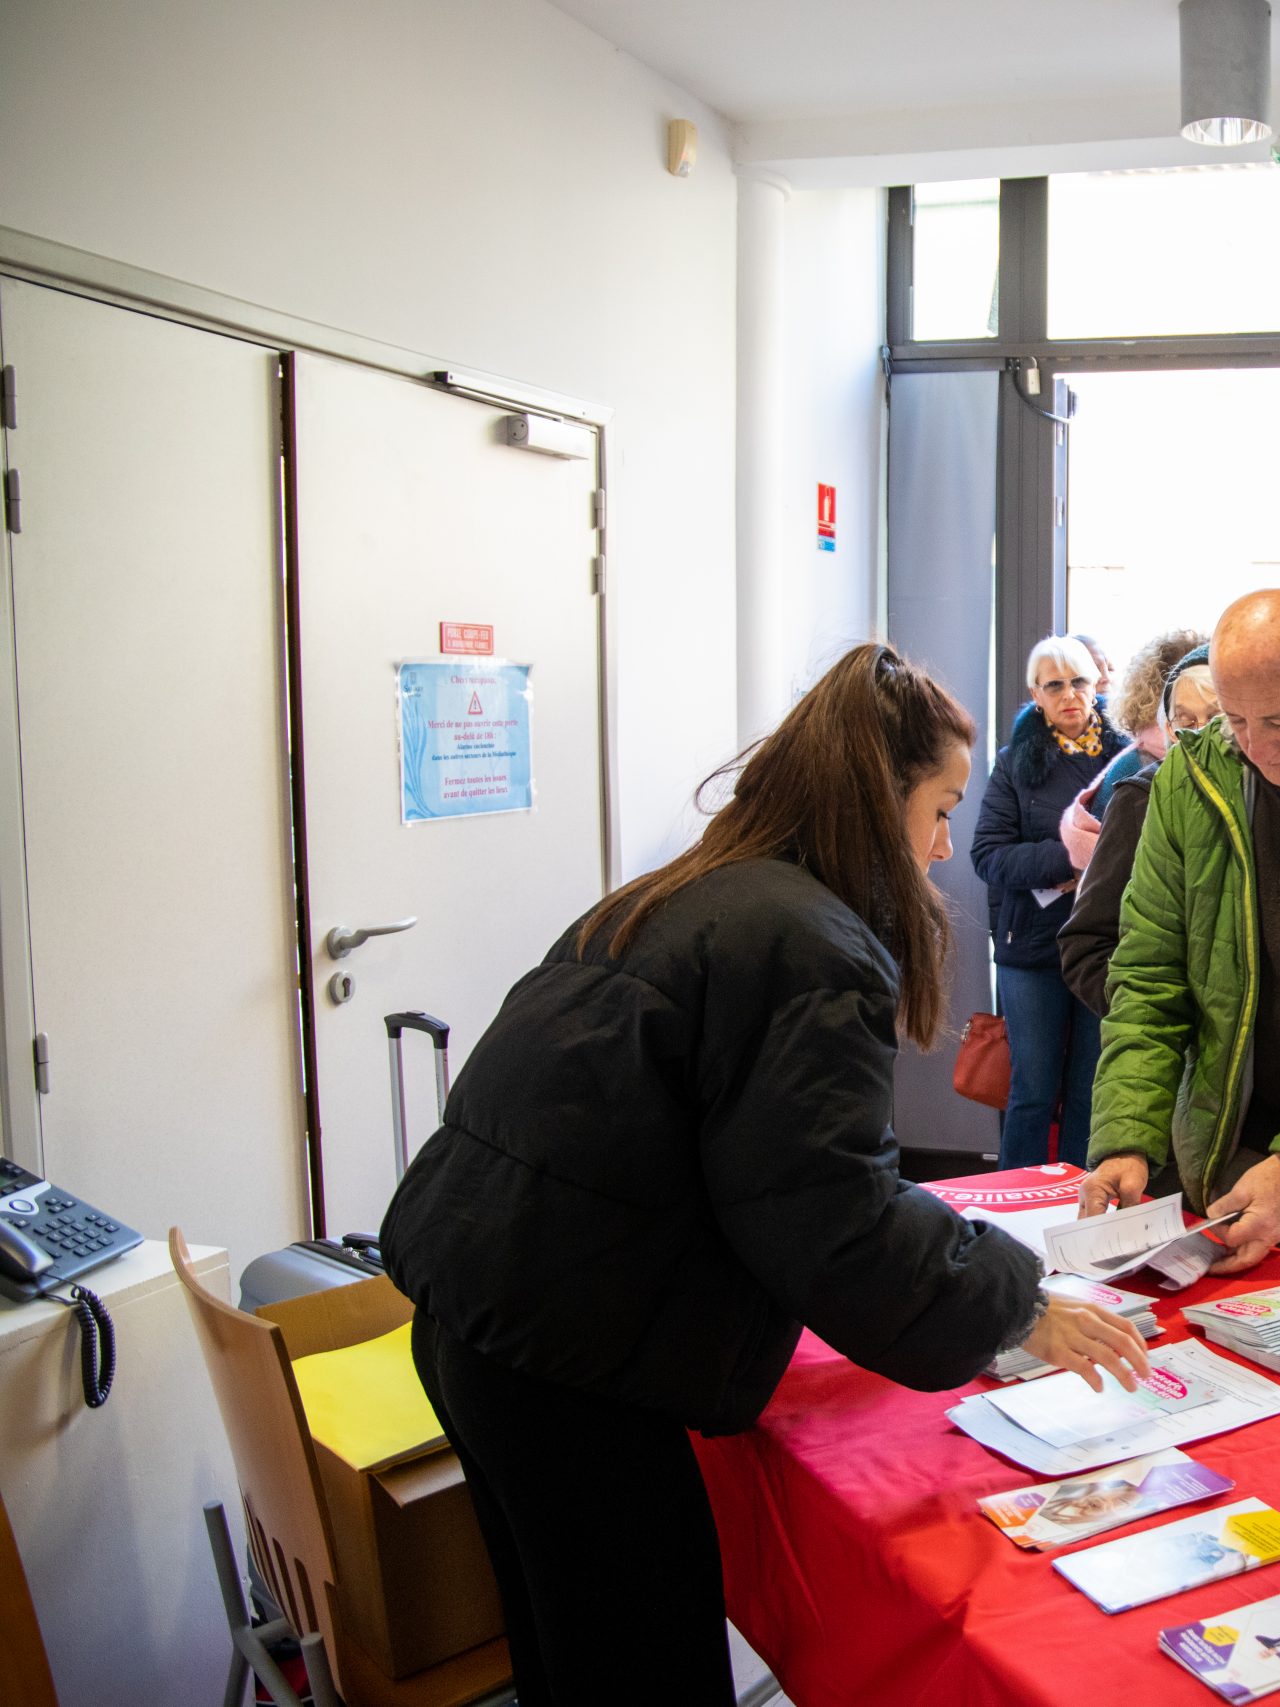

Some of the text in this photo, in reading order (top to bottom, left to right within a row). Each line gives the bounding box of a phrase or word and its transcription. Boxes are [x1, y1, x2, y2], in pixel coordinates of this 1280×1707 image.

[428, 720, 445, 729] Merci
[446, 719, 454, 728] de
[463, 721, 473, 730] pas
[444, 777, 466, 786] Fermez
[467, 776, 483, 784] toutes
[484, 775, 492, 783] les
[443, 790, 460, 799] avant
[461, 789, 468, 797] de
[468, 787, 487, 798] quitter
[487, 787, 495, 795] les
